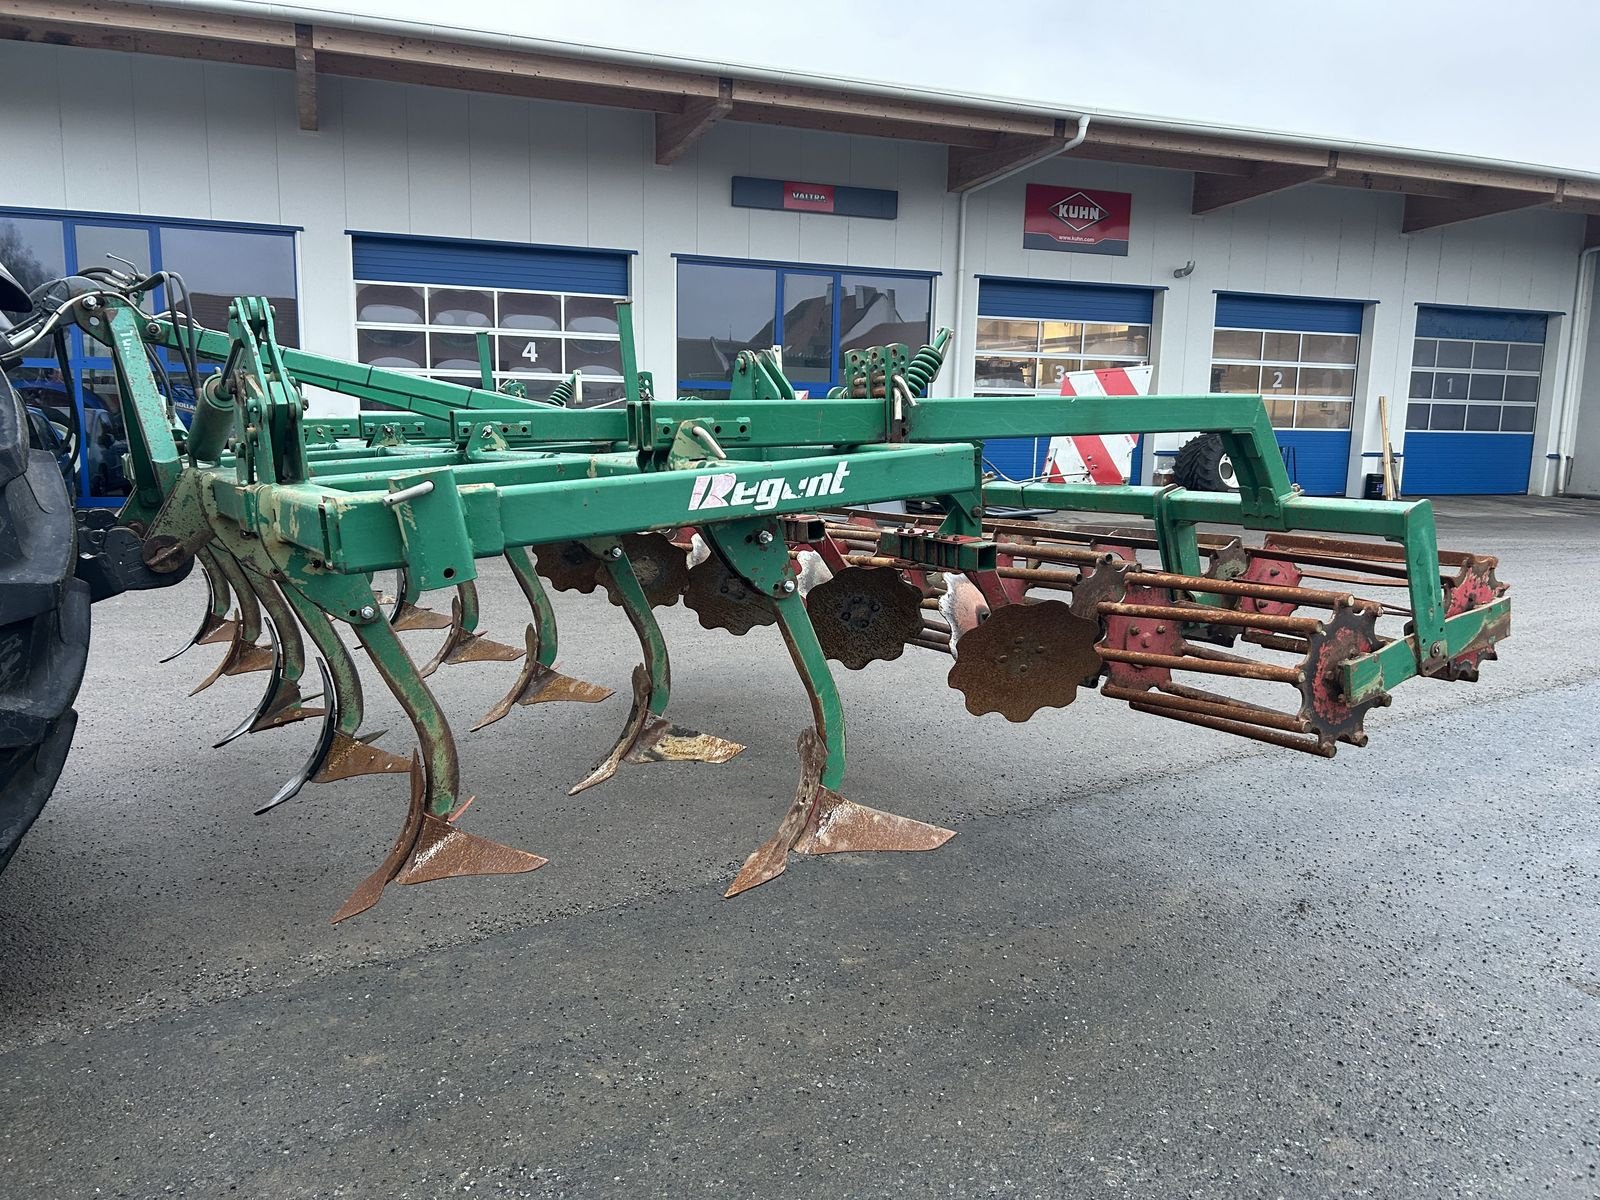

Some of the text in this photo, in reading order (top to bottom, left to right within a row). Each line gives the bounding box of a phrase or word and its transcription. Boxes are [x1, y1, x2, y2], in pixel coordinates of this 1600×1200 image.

[1058, 204, 1100, 220] KUHN
[1058, 235, 1096, 243] www.kuhn.com
[521, 341, 539, 363] 4
[1054, 365, 1065, 383] 3
[1272, 371, 1283, 388] 2
[1447, 377, 1454, 393] 1
